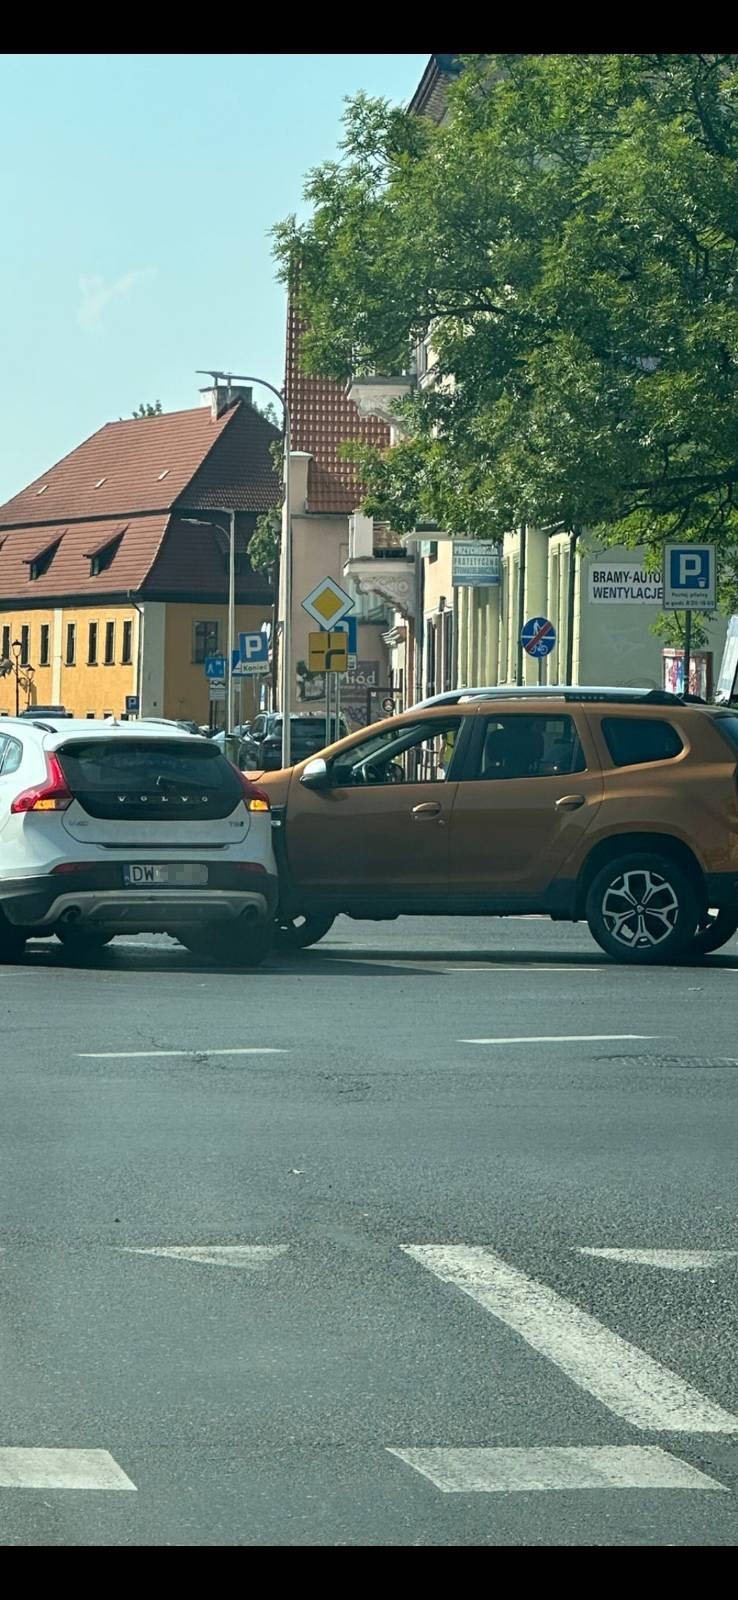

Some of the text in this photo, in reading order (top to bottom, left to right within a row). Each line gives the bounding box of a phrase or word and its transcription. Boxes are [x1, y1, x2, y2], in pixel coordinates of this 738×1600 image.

[679, 553, 702, 585] P
[592, 571, 664, 583] BRAMY-AUTO
[592, 587, 664, 599] WENTYLACJE
[245, 635, 262, 658] P
[243, 663, 268, 671] Koniec
[339, 670, 375, 684] Miód
